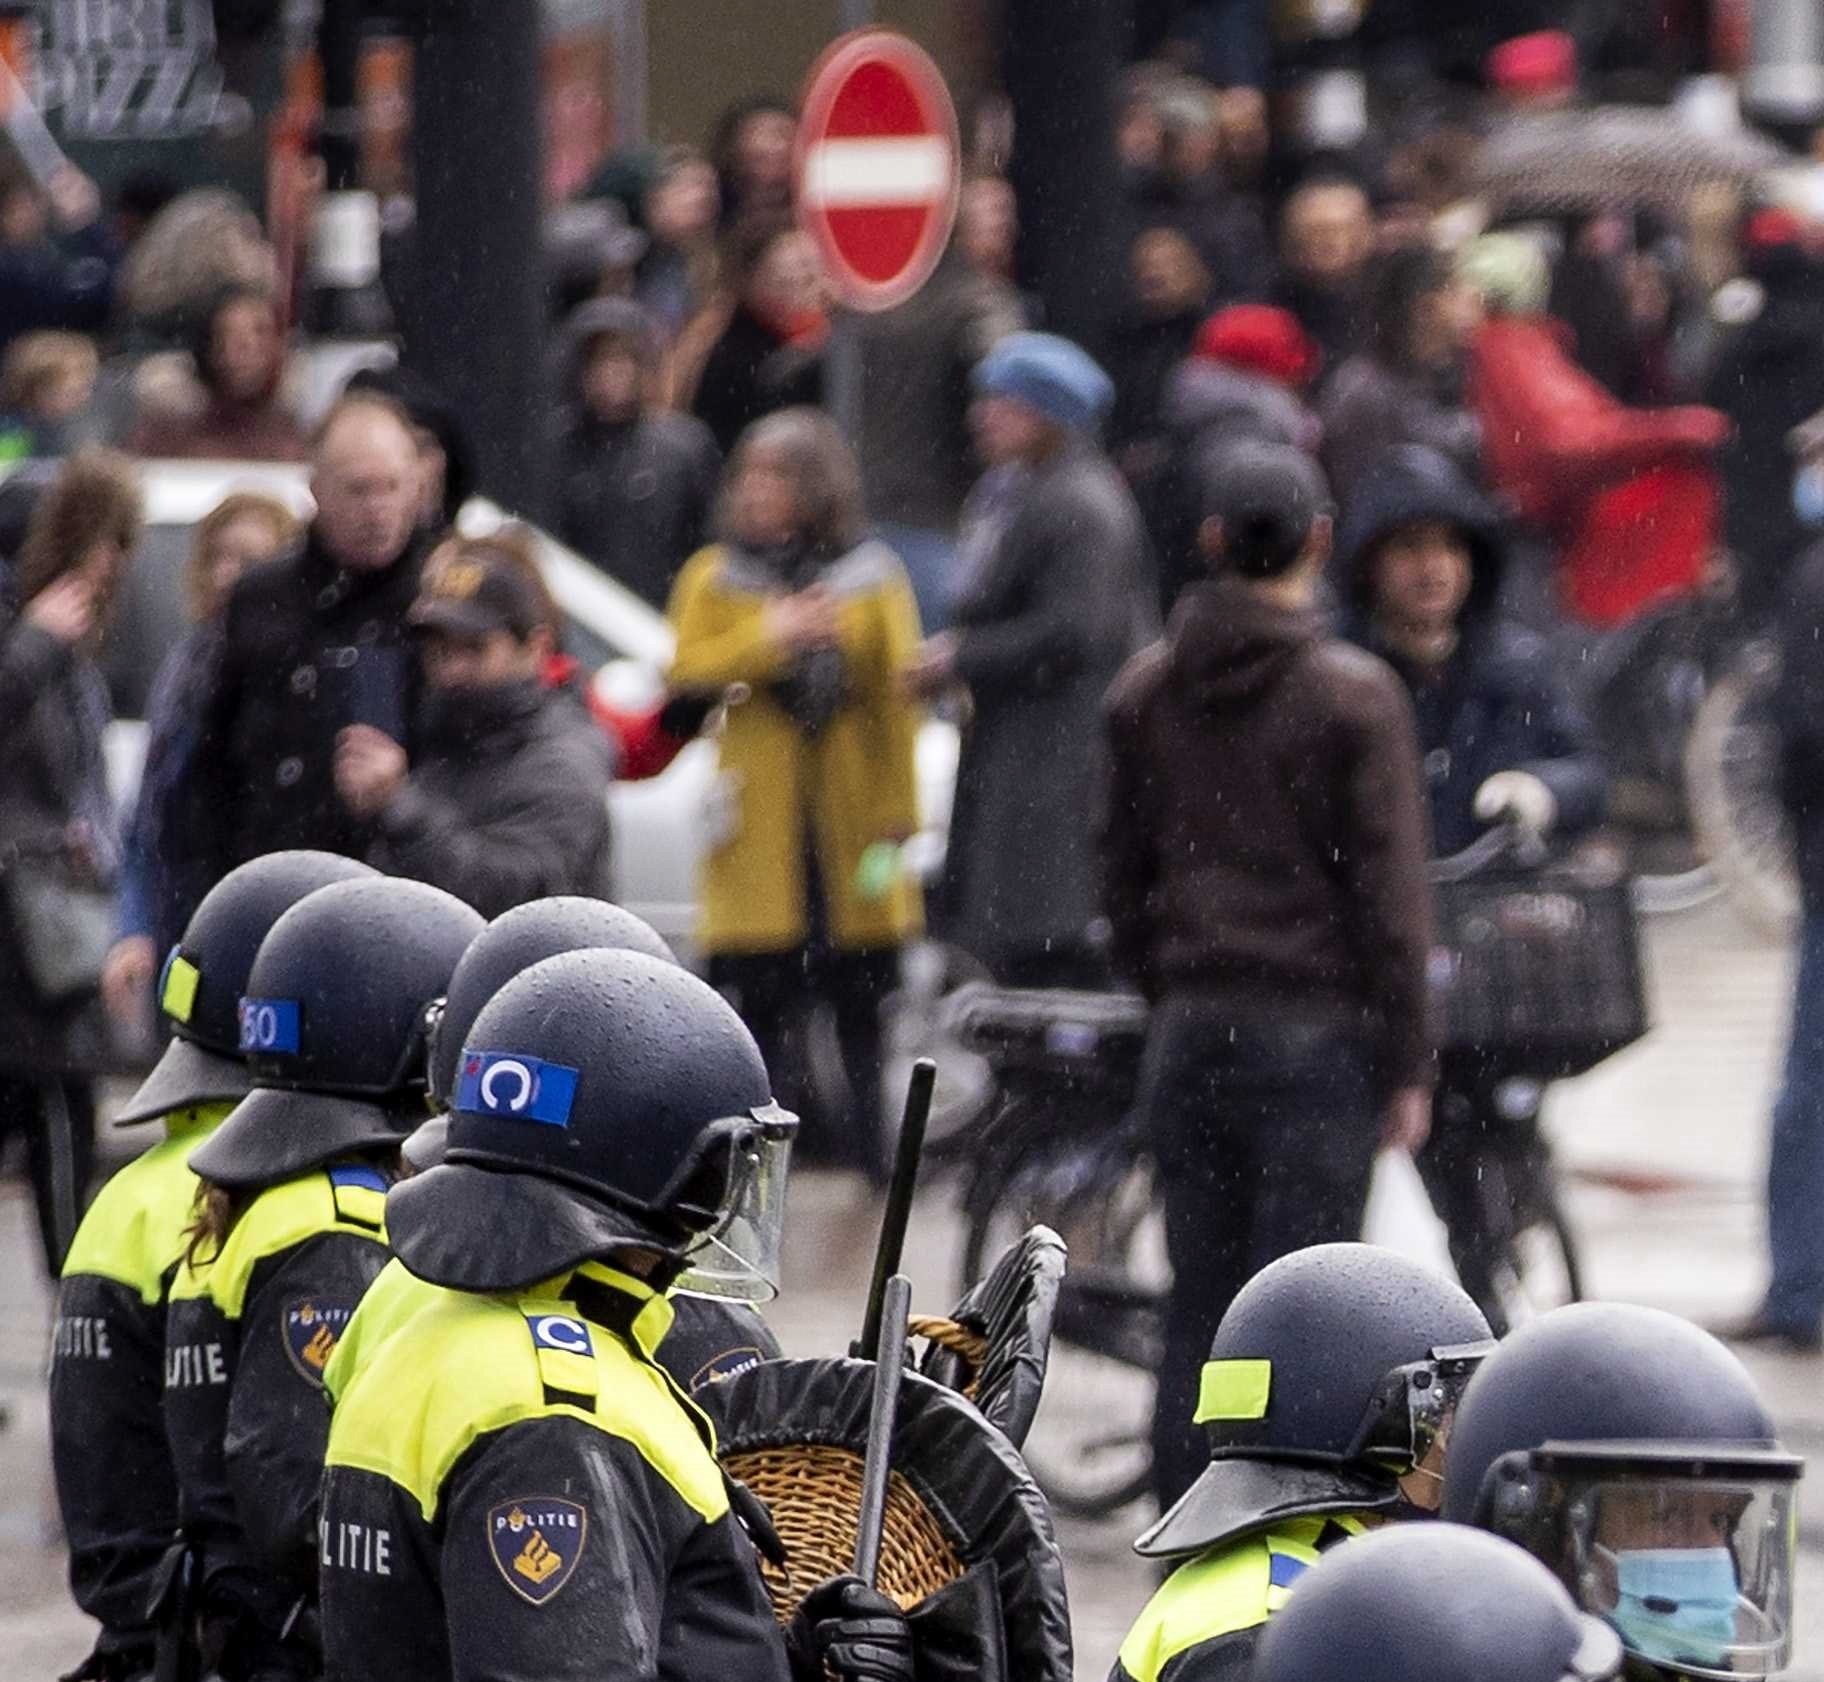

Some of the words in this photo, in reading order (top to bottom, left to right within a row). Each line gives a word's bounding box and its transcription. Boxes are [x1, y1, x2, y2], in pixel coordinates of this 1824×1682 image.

[289, 1305, 350, 1326] POLITI
[536, 1315, 588, 1352] C
[495, 1508, 577, 1533] POLITIE
